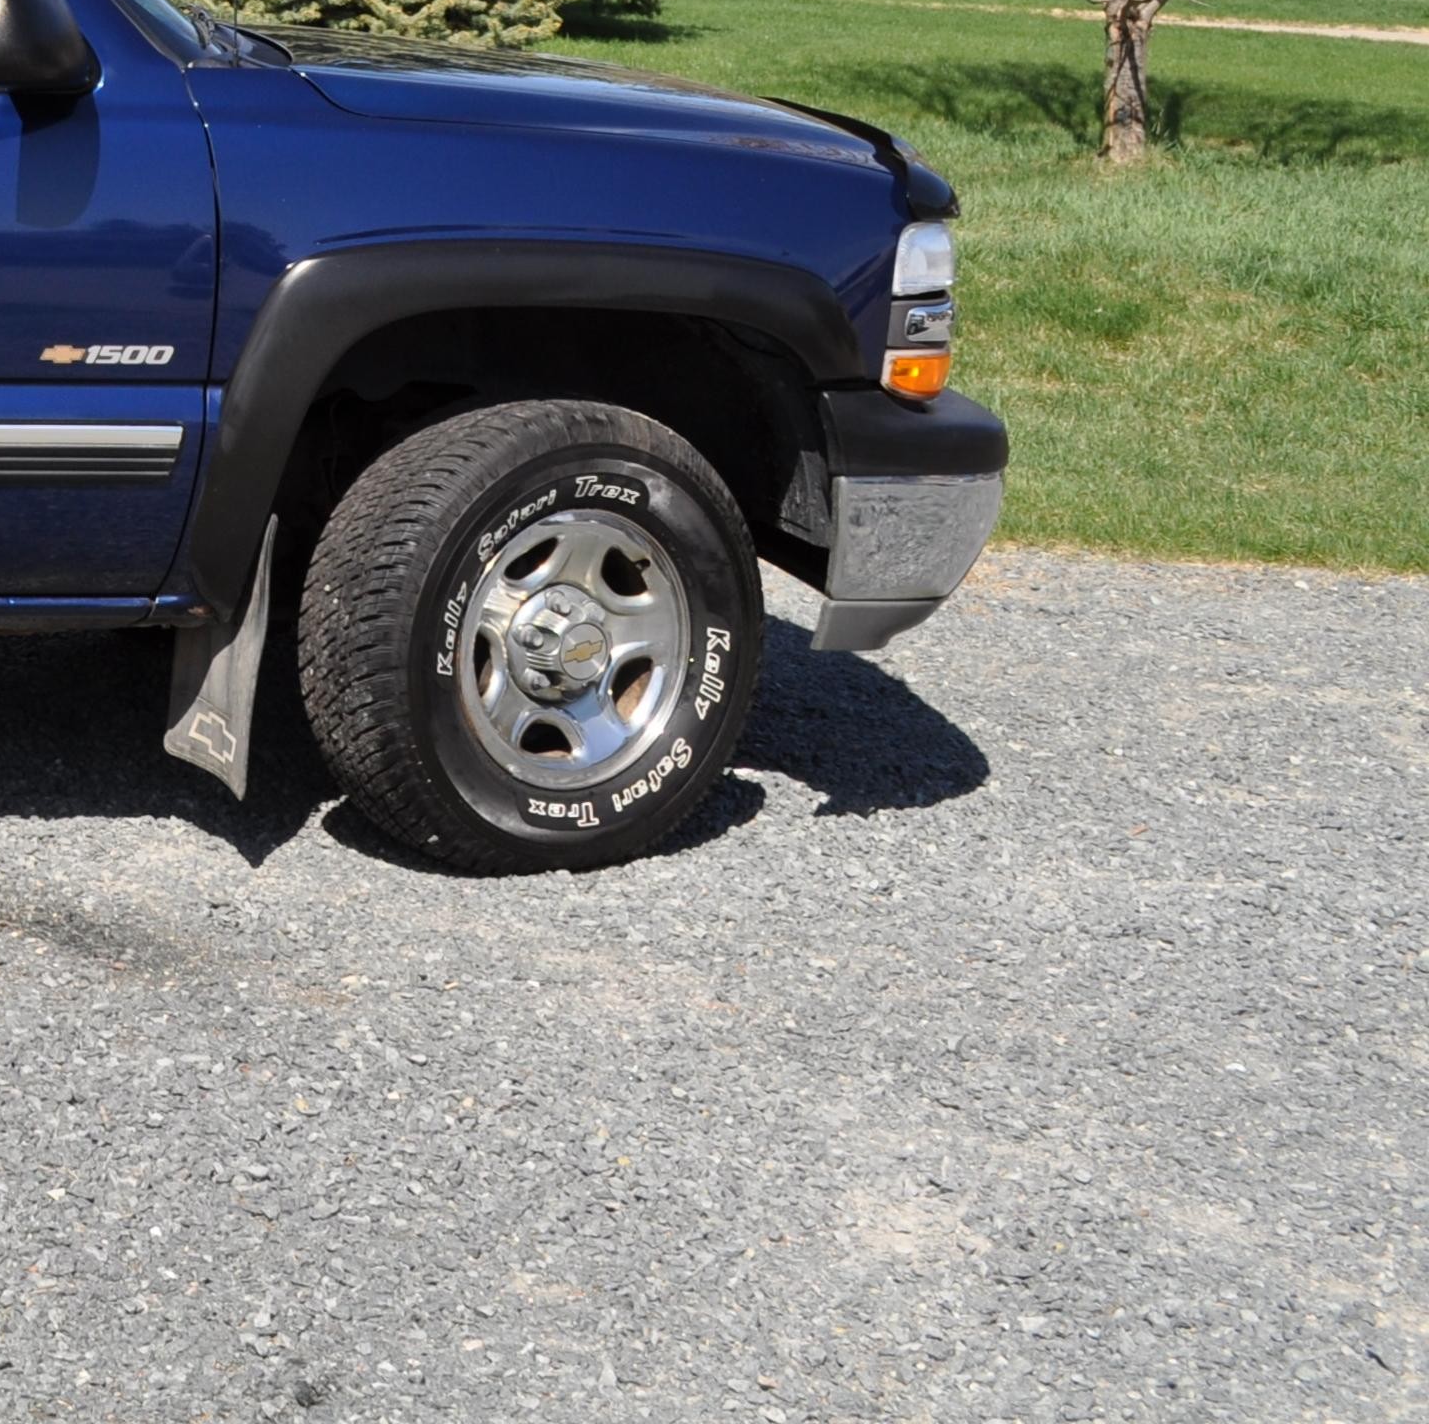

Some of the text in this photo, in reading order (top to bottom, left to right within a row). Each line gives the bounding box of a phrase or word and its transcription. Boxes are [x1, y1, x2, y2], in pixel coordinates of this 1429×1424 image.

[84, 344, 175, 365] 1500
[437, 475, 642, 677] Kelly Safari Trex
[528, 626, 731, 827] Kelly Safari Trex
